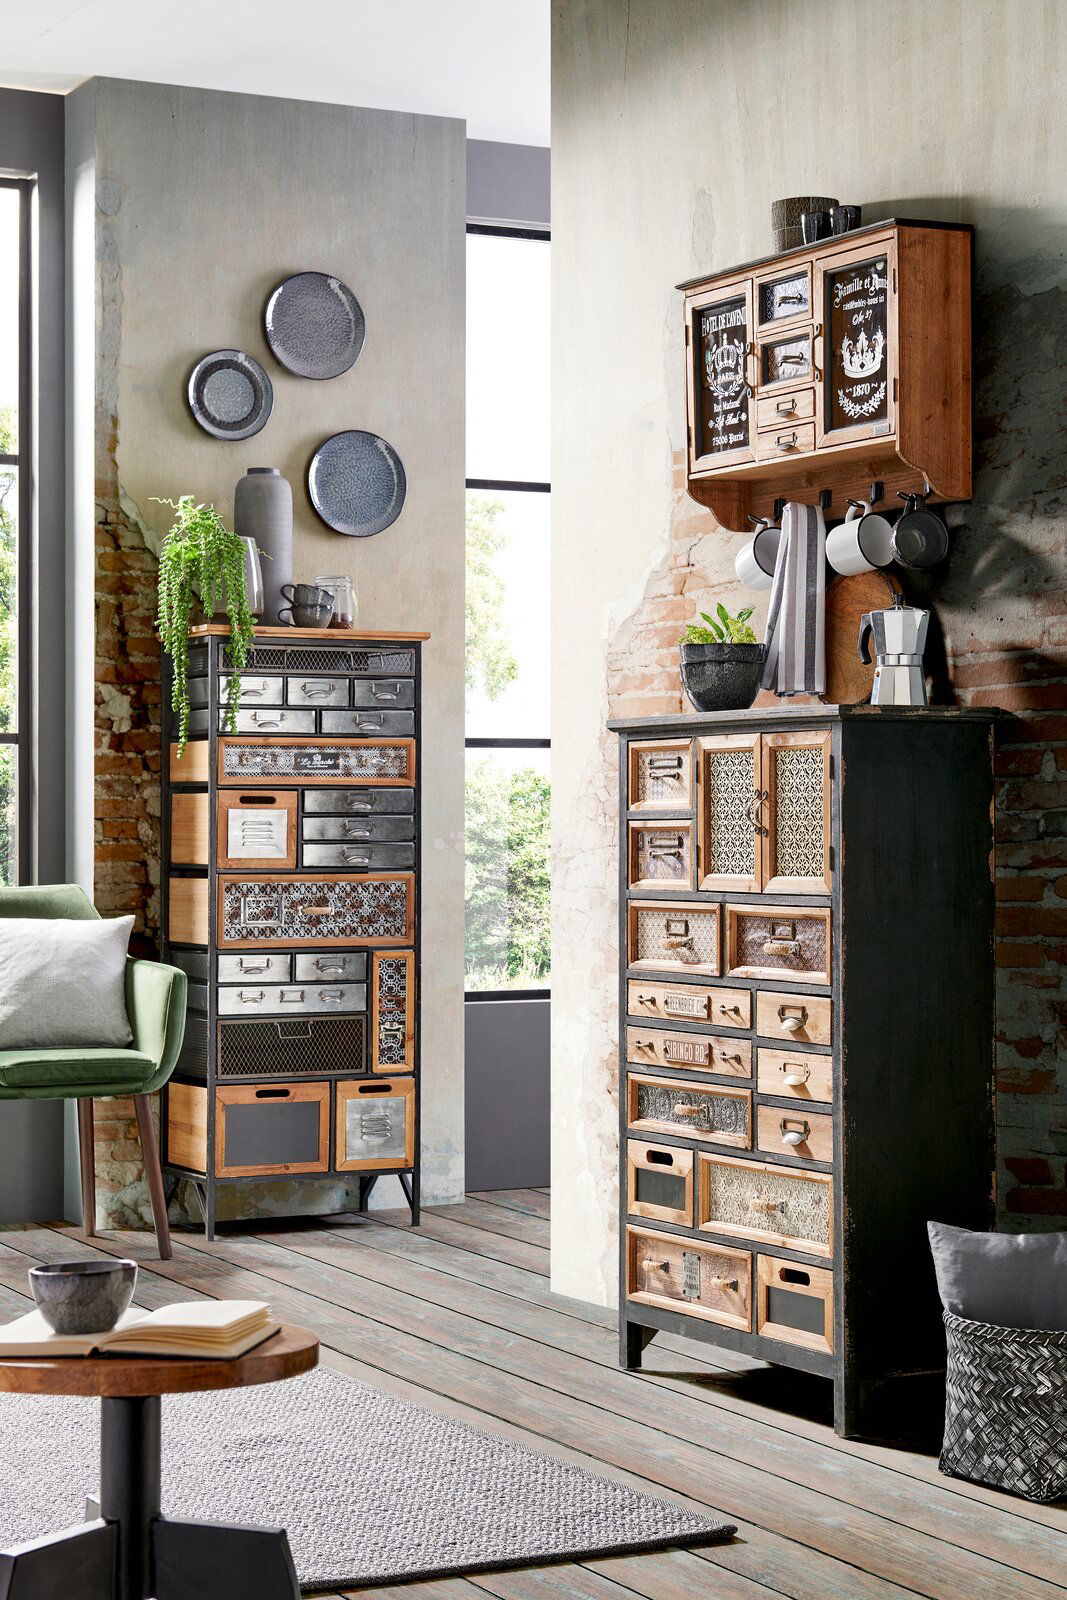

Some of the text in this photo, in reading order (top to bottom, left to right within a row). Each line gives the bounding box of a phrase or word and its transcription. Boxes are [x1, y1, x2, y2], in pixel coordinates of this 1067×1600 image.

[834, 273, 888, 308] Famille et Ami
[718, 313, 726, 330] DE
[717, 372, 735, 383] PARIS
[852, 382, 870, 397] 1870
[728, 432, 744, 445] Paris
[665, 1040, 706, 1063] SIRINGO RD.
